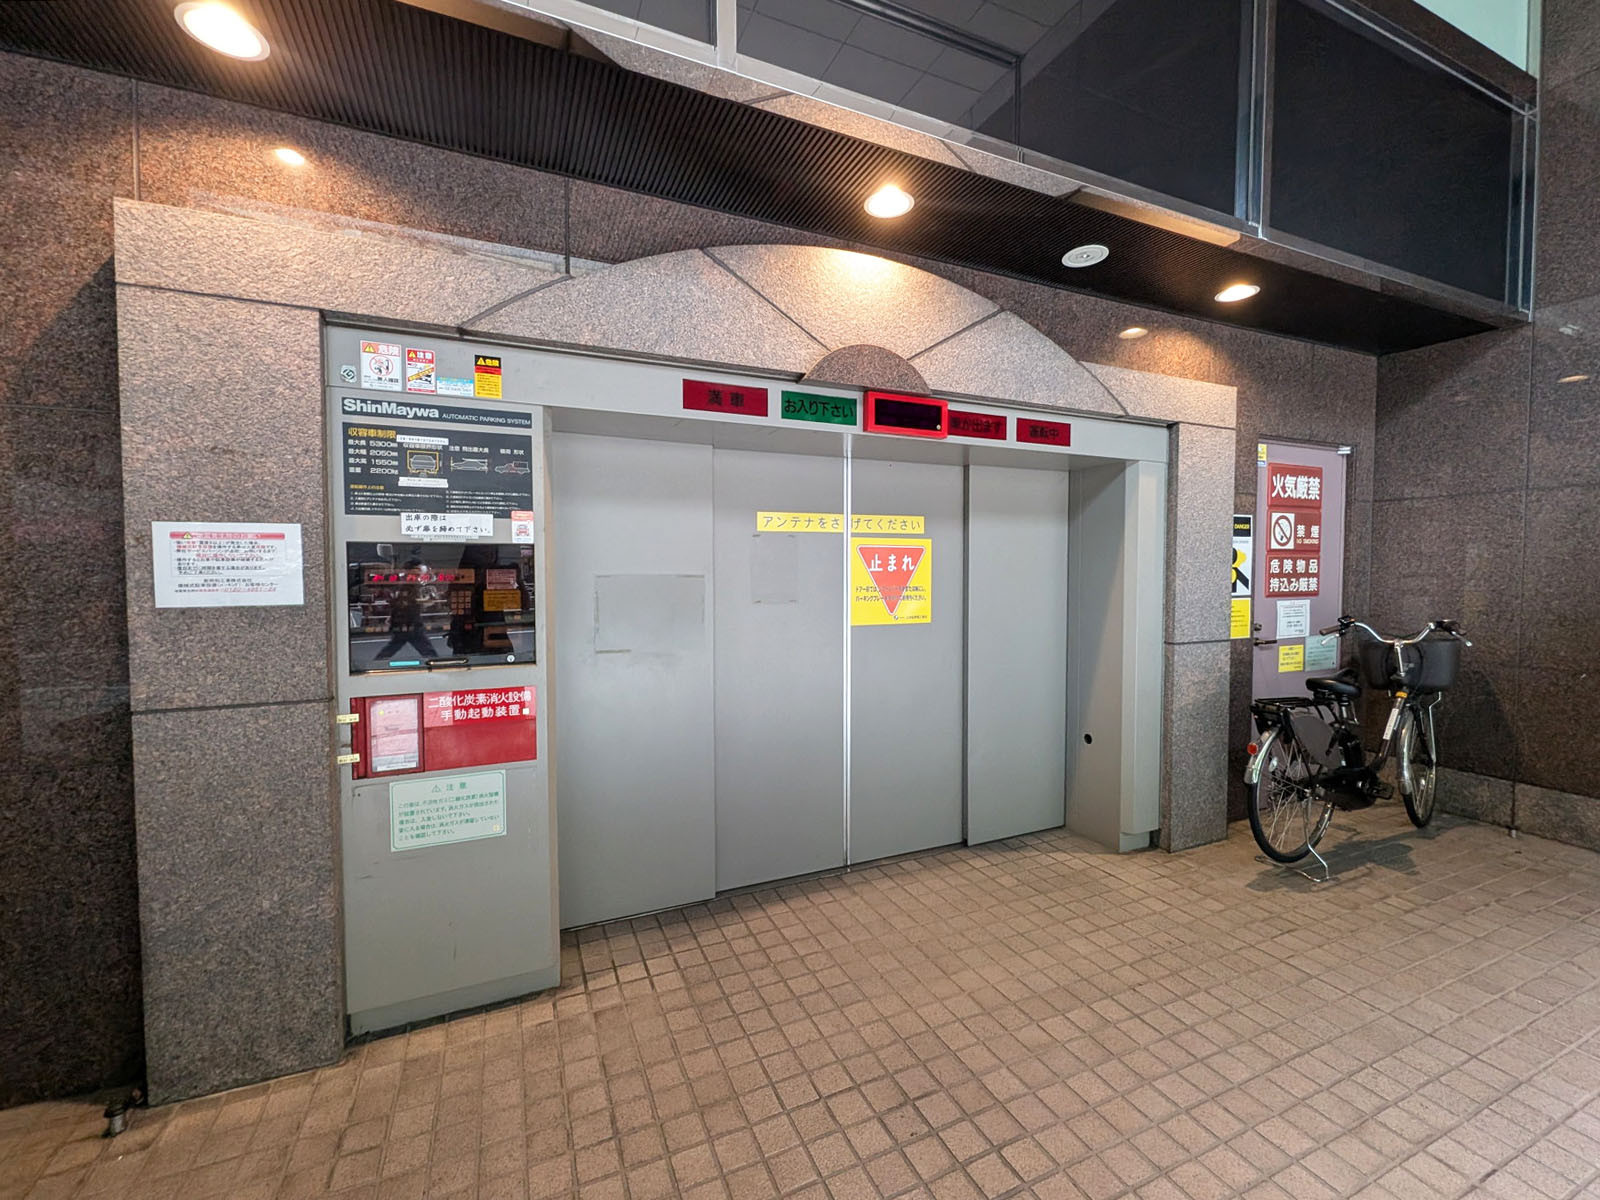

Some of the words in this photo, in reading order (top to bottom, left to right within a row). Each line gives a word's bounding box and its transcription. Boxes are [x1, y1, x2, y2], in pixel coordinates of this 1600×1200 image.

[343, 399, 439, 418] ShinMaywa
[442, 413, 479, 421] AUTOMATIC
[480, 415, 506, 423] PARKING
[784, 398, 855, 418] お入り下さい
[1271, 473, 1320, 500] 火気厳禁
[763, 516, 920, 531] アンテナをさげてください
[1296, 524, 1319, 538] 禁煙
[868, 553, 915, 572] 止まれ
[1270, 558, 1318, 574] 危険物品
[1269, 577, 1318, 592] 持込み厳禁
[428, 690, 532, 708] 二酸化炭素消火設備
[441, 704, 521, 720] 手動起動装置
